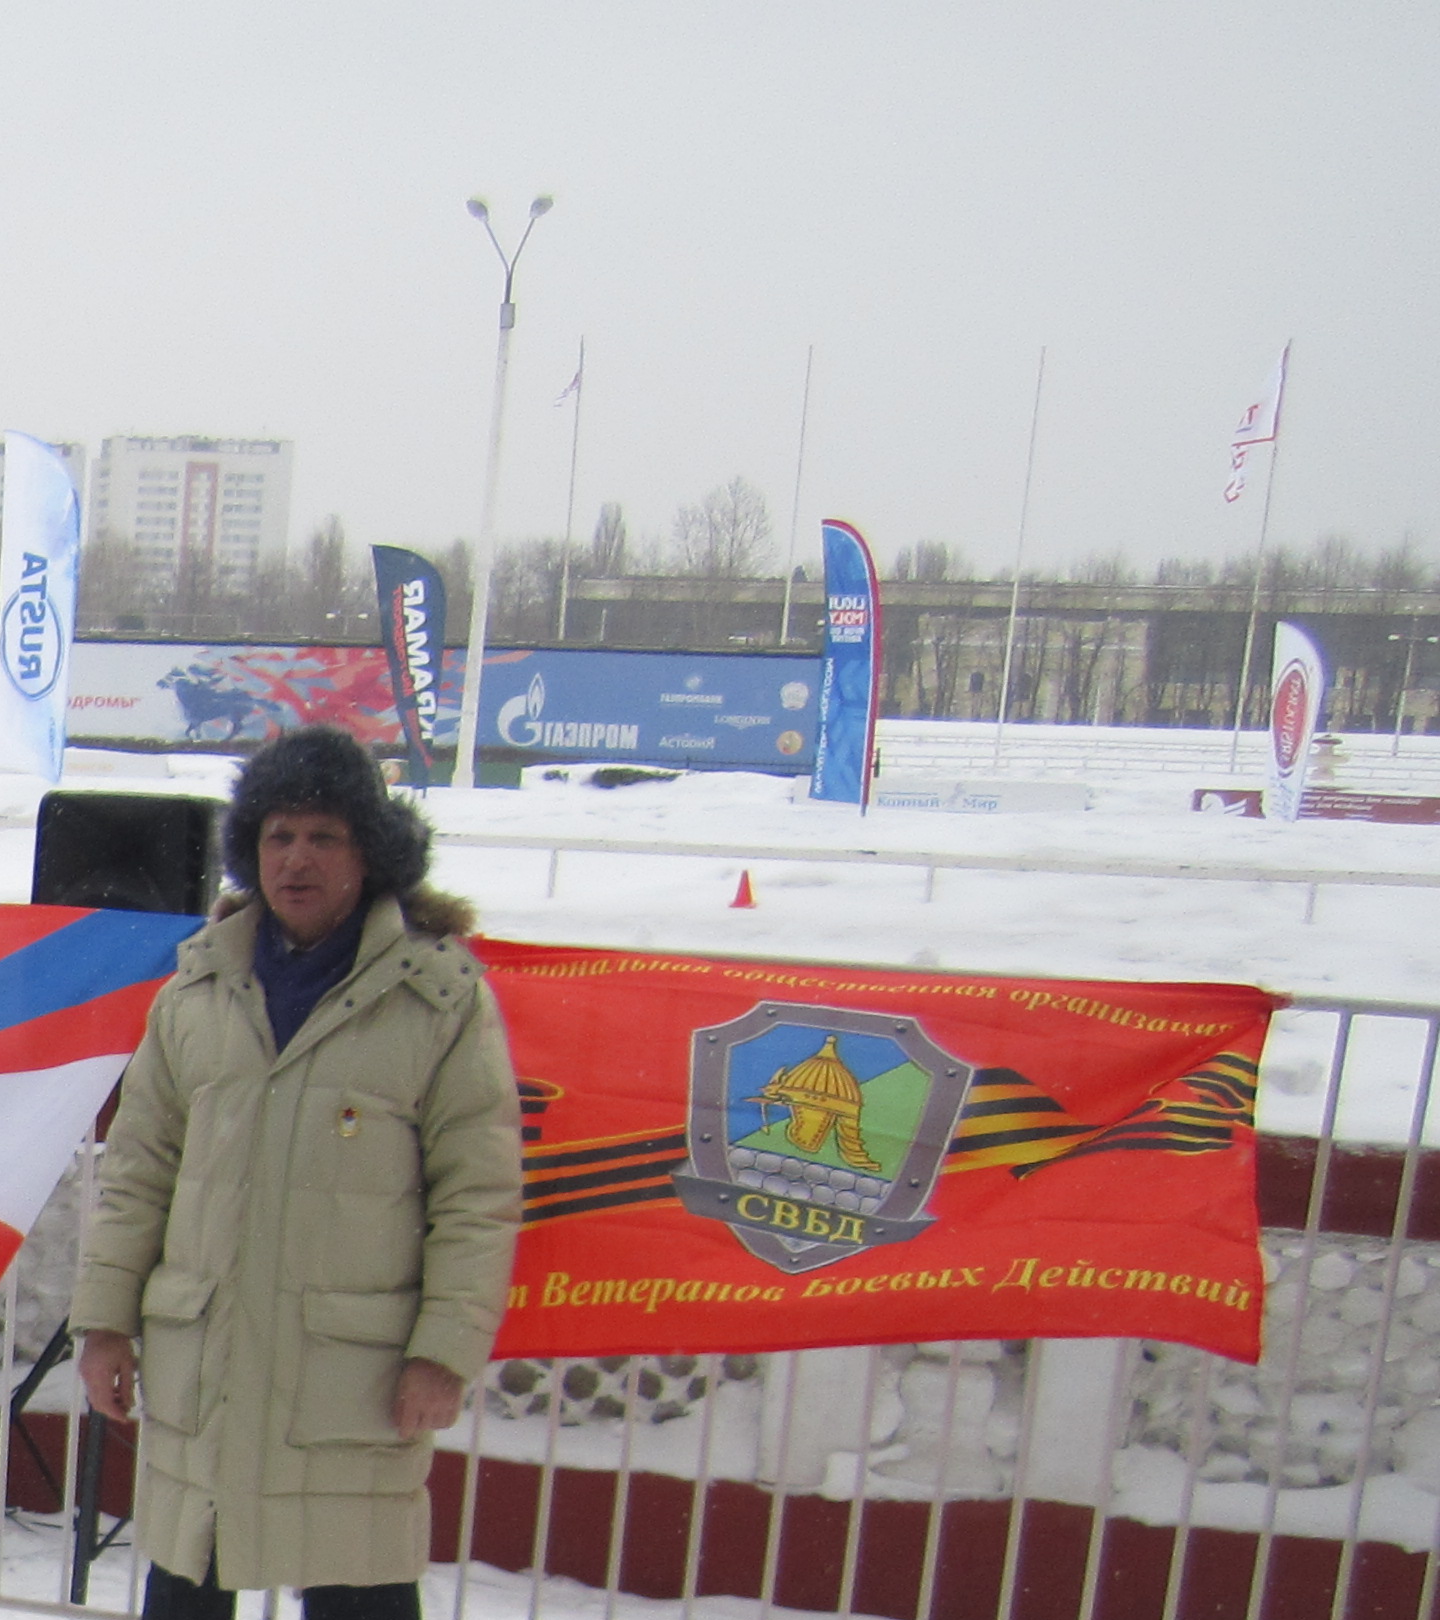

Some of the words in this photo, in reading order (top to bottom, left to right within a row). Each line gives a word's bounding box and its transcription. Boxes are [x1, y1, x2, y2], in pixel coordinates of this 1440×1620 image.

[544, 722, 639, 750] ГАЗПРОМ
[963, 797, 998, 811] Мир
[737, 1193, 865, 1244] СВБД
[540, 1271, 786, 1313] Ветеранов
[800, 1265, 985, 1299] Боевых
[991, 1258, 1253, 1311] Действий
